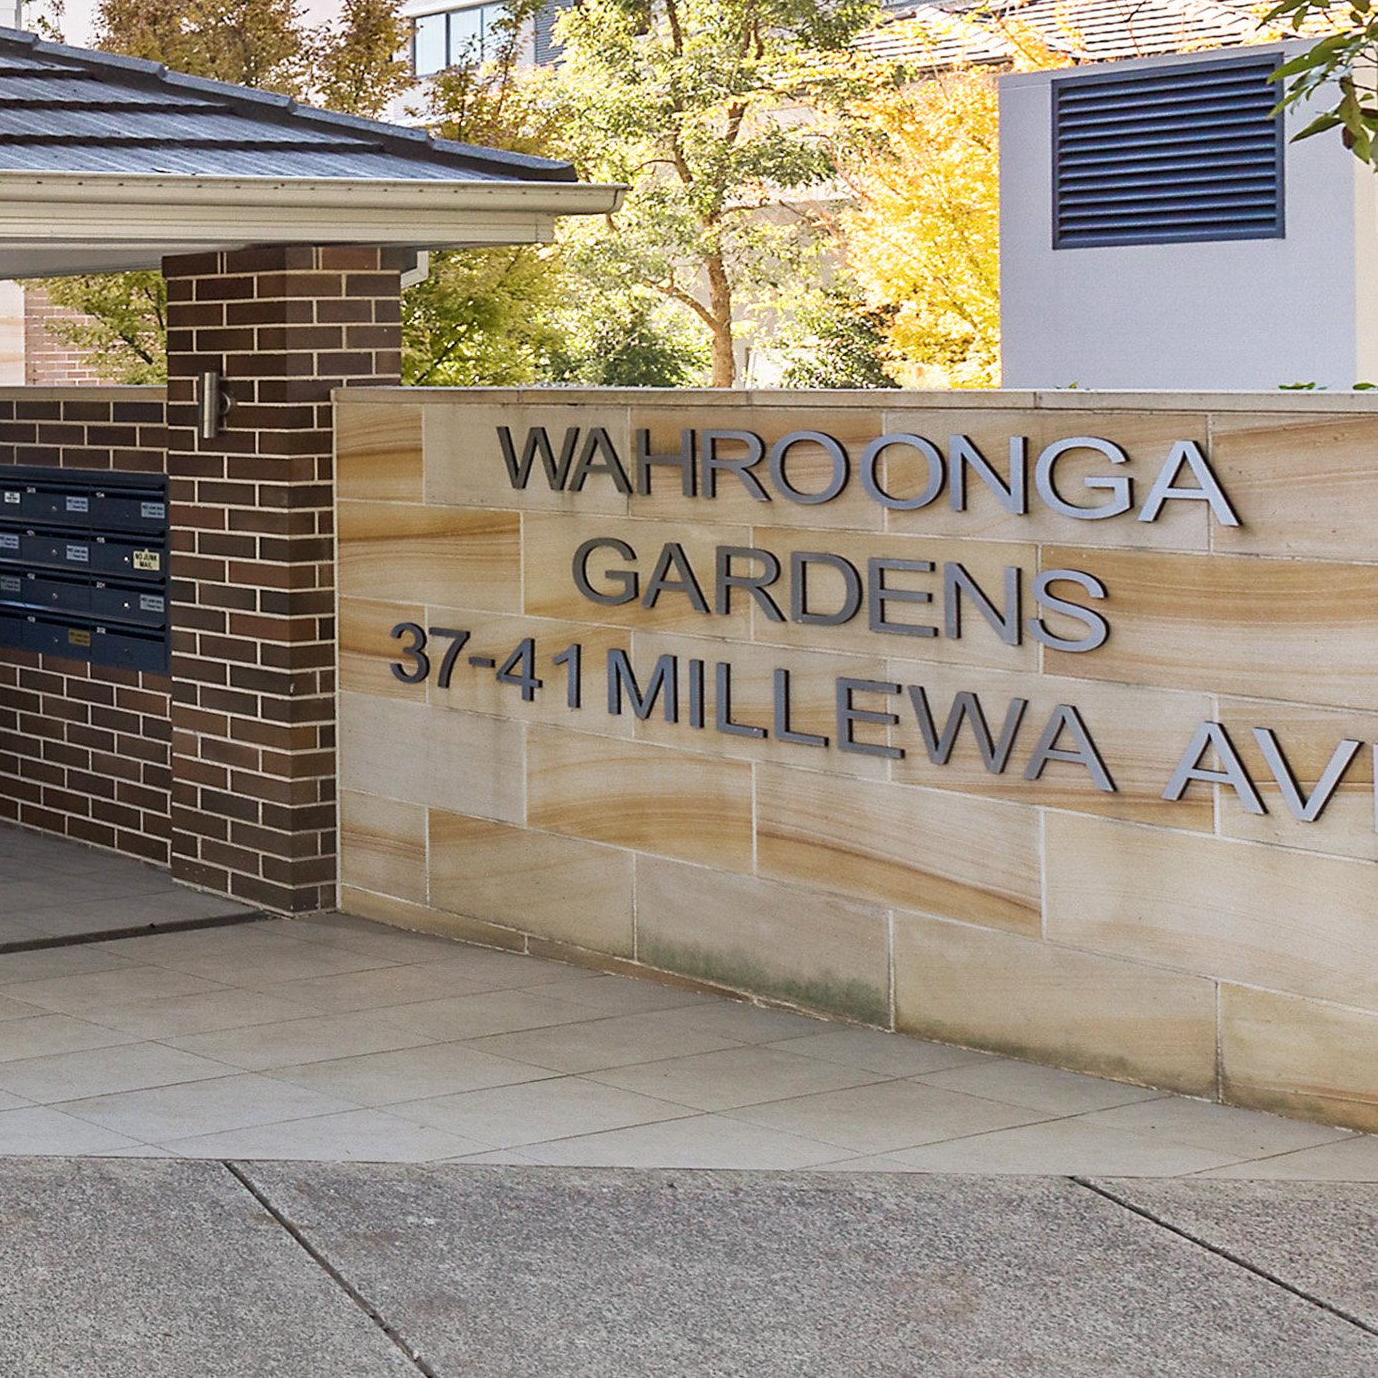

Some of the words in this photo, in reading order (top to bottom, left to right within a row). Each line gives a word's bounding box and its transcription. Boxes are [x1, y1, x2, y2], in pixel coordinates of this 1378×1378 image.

[496, 426, 1242, 528] WAHROONGA
[571, 536, 1111, 654] GARDENS
[390, 622, 582, 709] 37-41
[607, 648, 1119, 793] MILLEWA
[1160, 720, 1378, 834] AV
